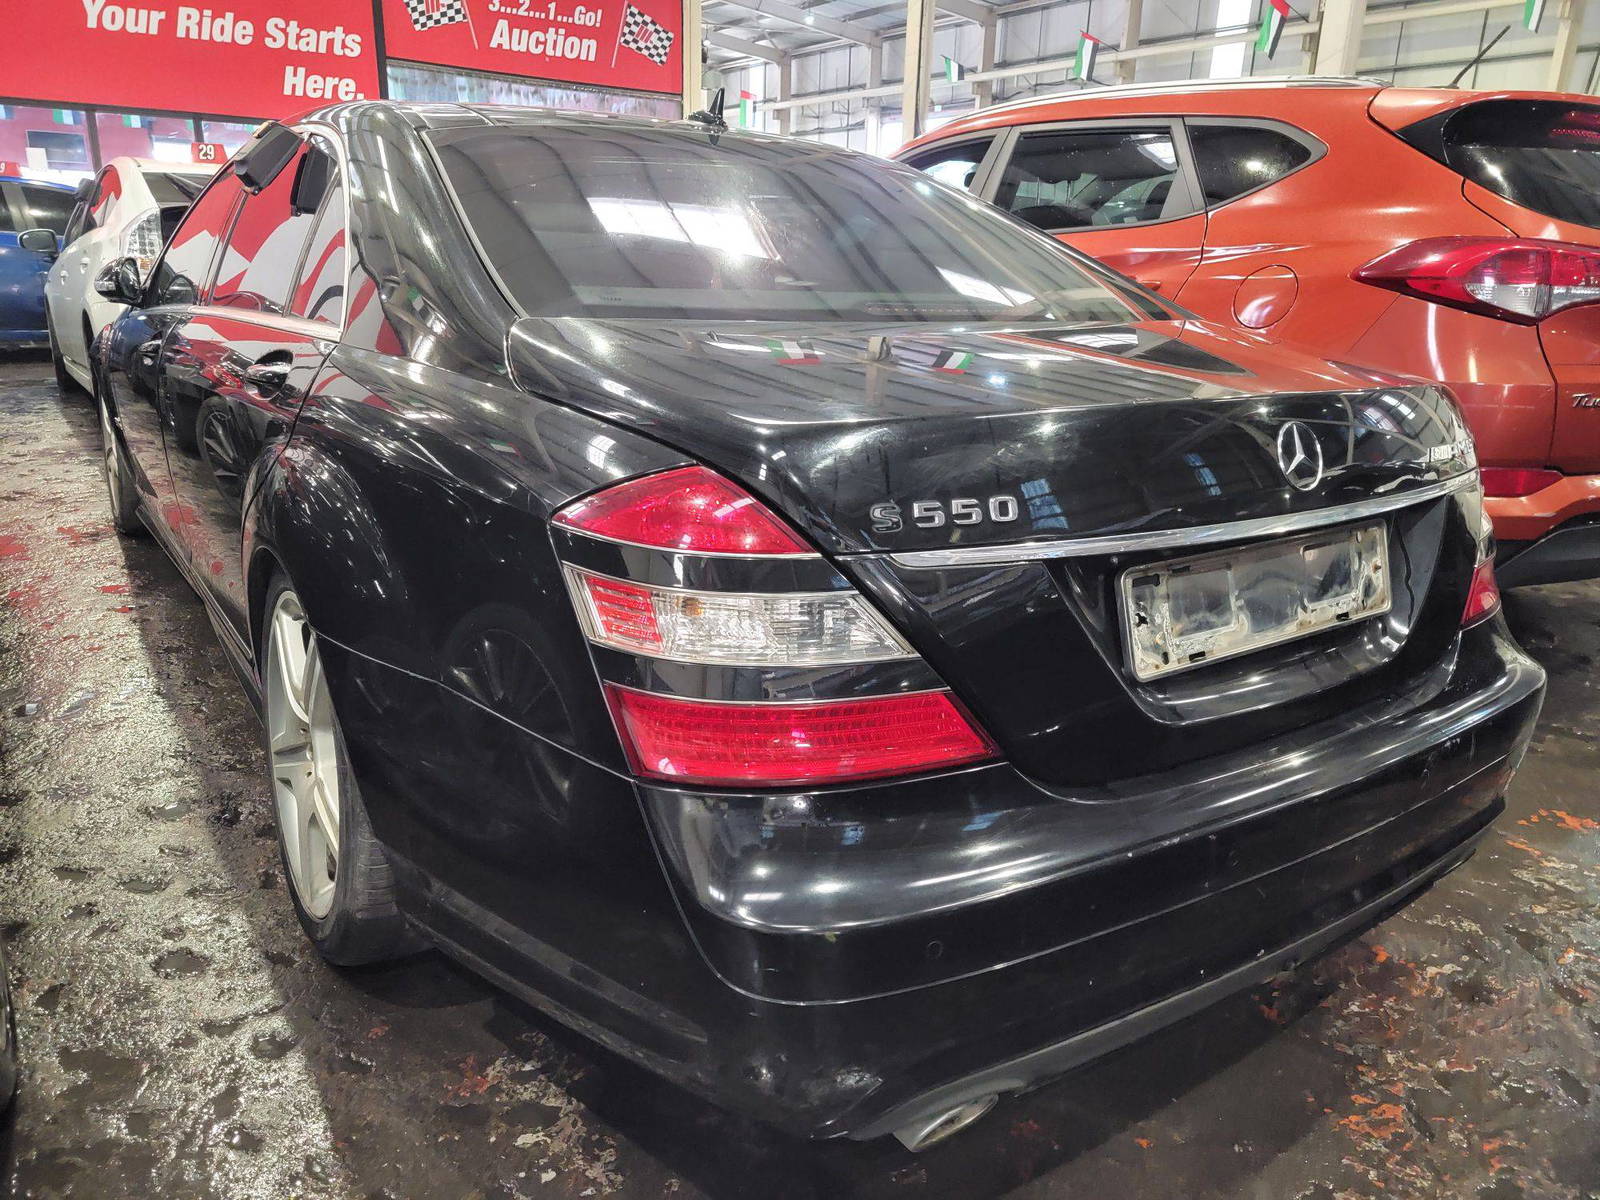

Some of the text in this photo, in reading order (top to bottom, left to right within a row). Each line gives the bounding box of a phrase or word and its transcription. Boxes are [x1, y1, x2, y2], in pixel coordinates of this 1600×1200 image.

[83, 0, 362, 57] Your Ride Starts
[489, 19, 597, 61] Auction
[283, 65, 365, 101] Here.
[199, 144, 215, 160] 29
